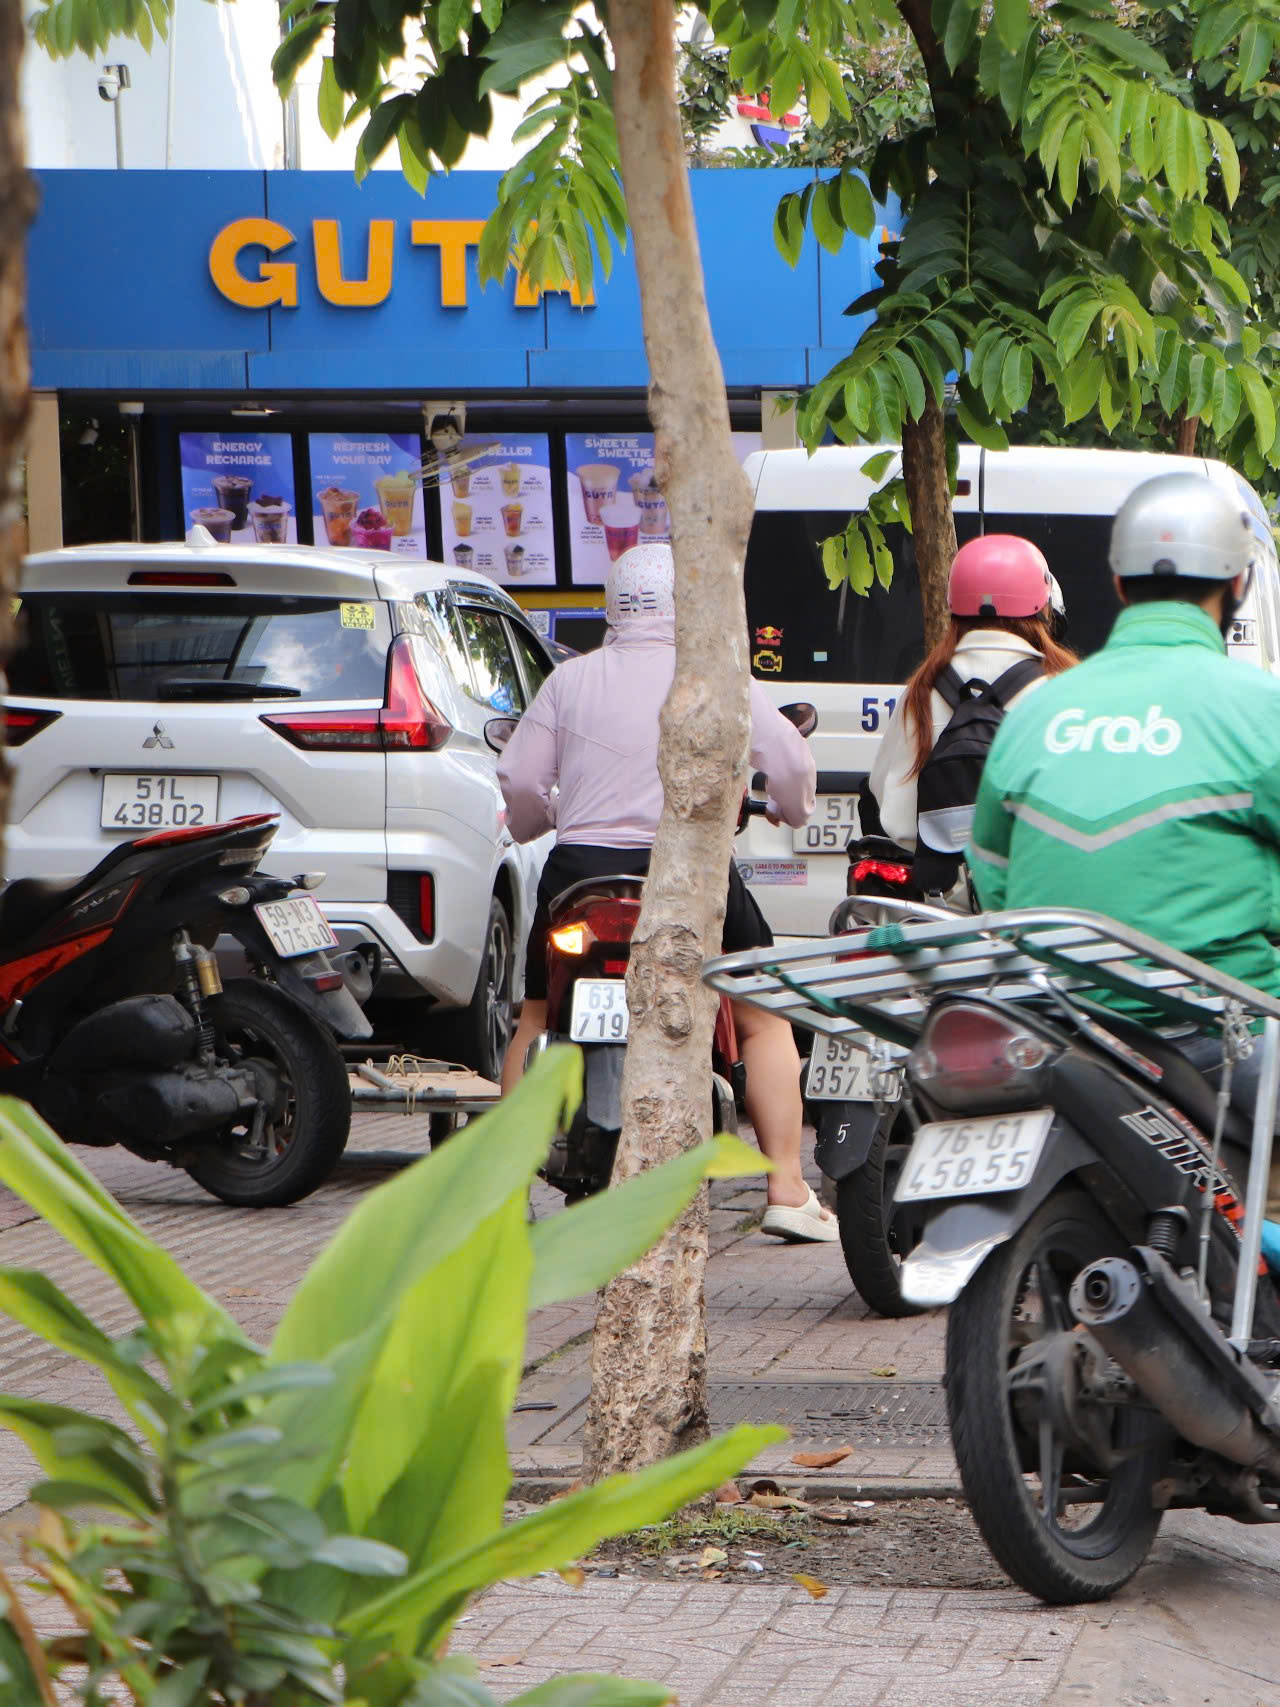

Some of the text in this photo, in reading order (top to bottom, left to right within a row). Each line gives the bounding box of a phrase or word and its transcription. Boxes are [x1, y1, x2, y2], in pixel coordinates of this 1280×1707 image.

[212, 442, 263, 452] ENERGY
[333, 442, 391, 452] REFRESH
[584, 439, 639, 448] SWEETIE
[597, 448, 652, 458] SWEETIE
[206, 455, 272, 465] RECHARGE
[333, 455, 392, 465] YOUR DAY
[1044, 703, 1183, 756] Grab
[136, 777, 184, 800] 51L
[114, 802, 205, 825] 438.02
[827, 798, 856, 821] 51
[807, 825, 854, 848] 057
[265, 900, 314, 928] 59-N3
[589, 985, 624, 1010] 63-
[836, 1123, 852, 1144] 5
[931, 1118, 1025, 1158] 76-G1
[909, 1150, 1029, 1193] 458.55
